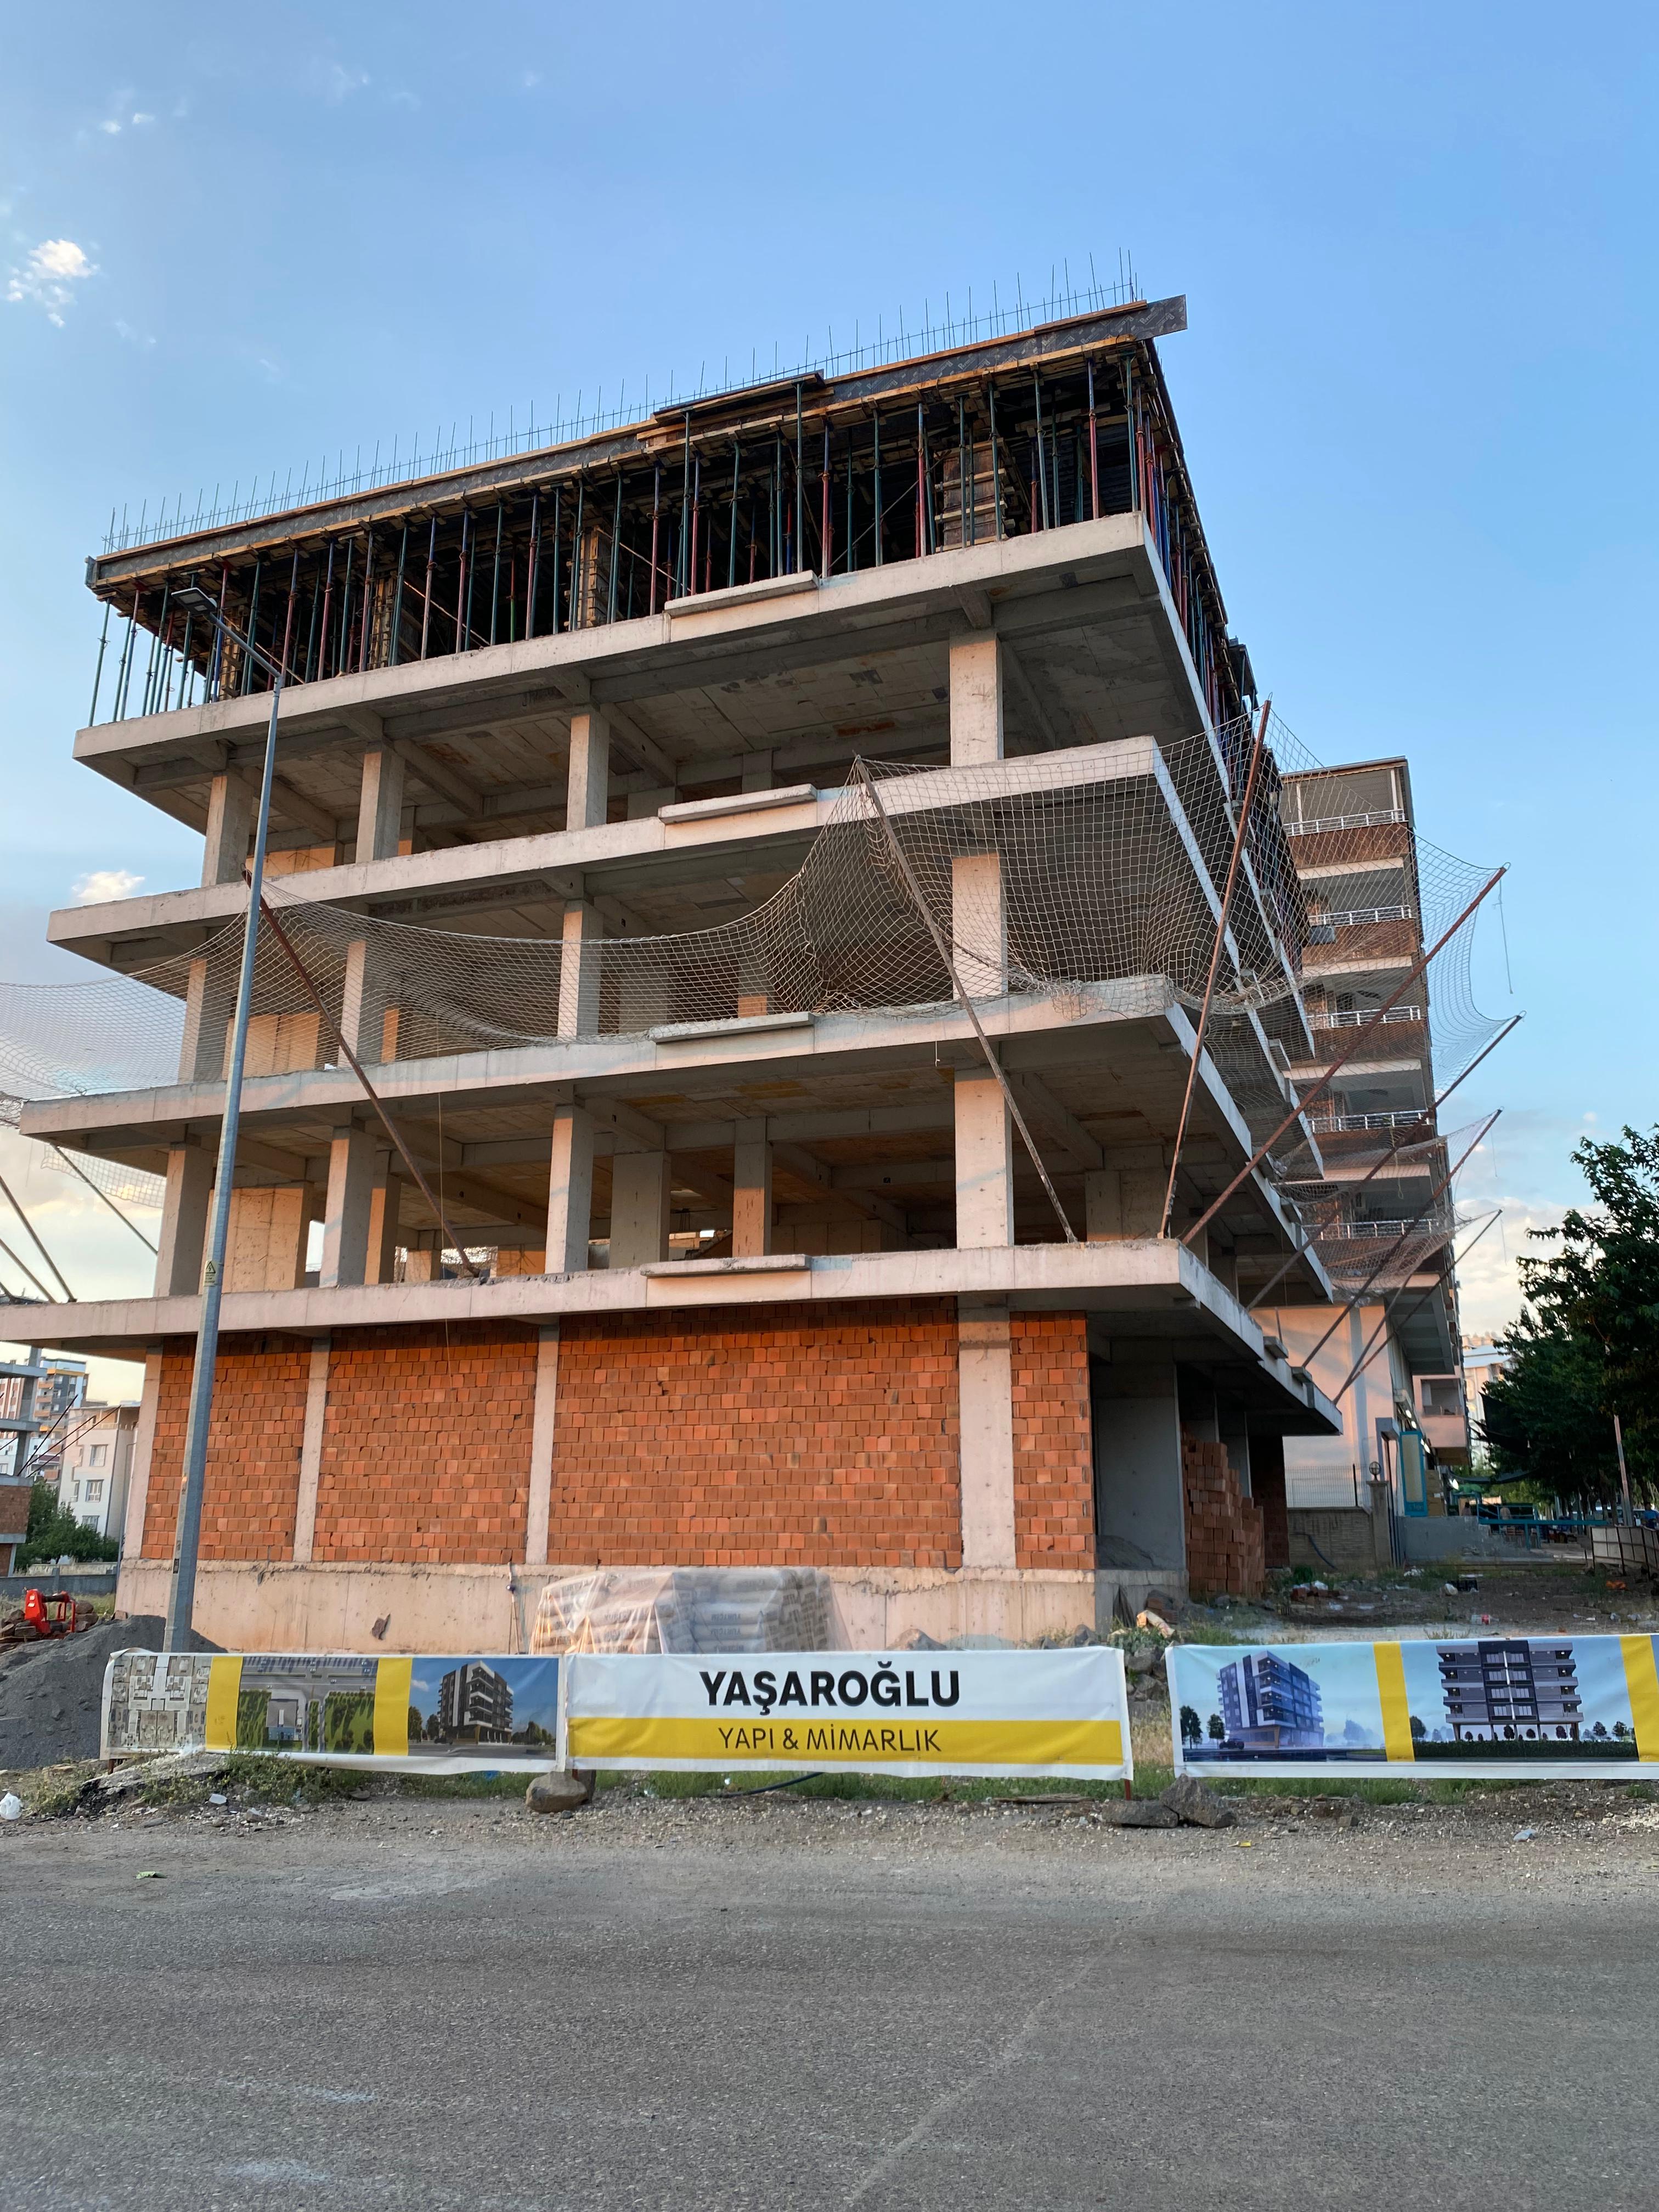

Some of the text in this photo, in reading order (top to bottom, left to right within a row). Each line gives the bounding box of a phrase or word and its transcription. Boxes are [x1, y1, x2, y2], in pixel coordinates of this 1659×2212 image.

[699, 1661, 960, 1716] YAŞAROĞLU
[718, 1723, 942, 1752] YAPI & MİMARLIK
